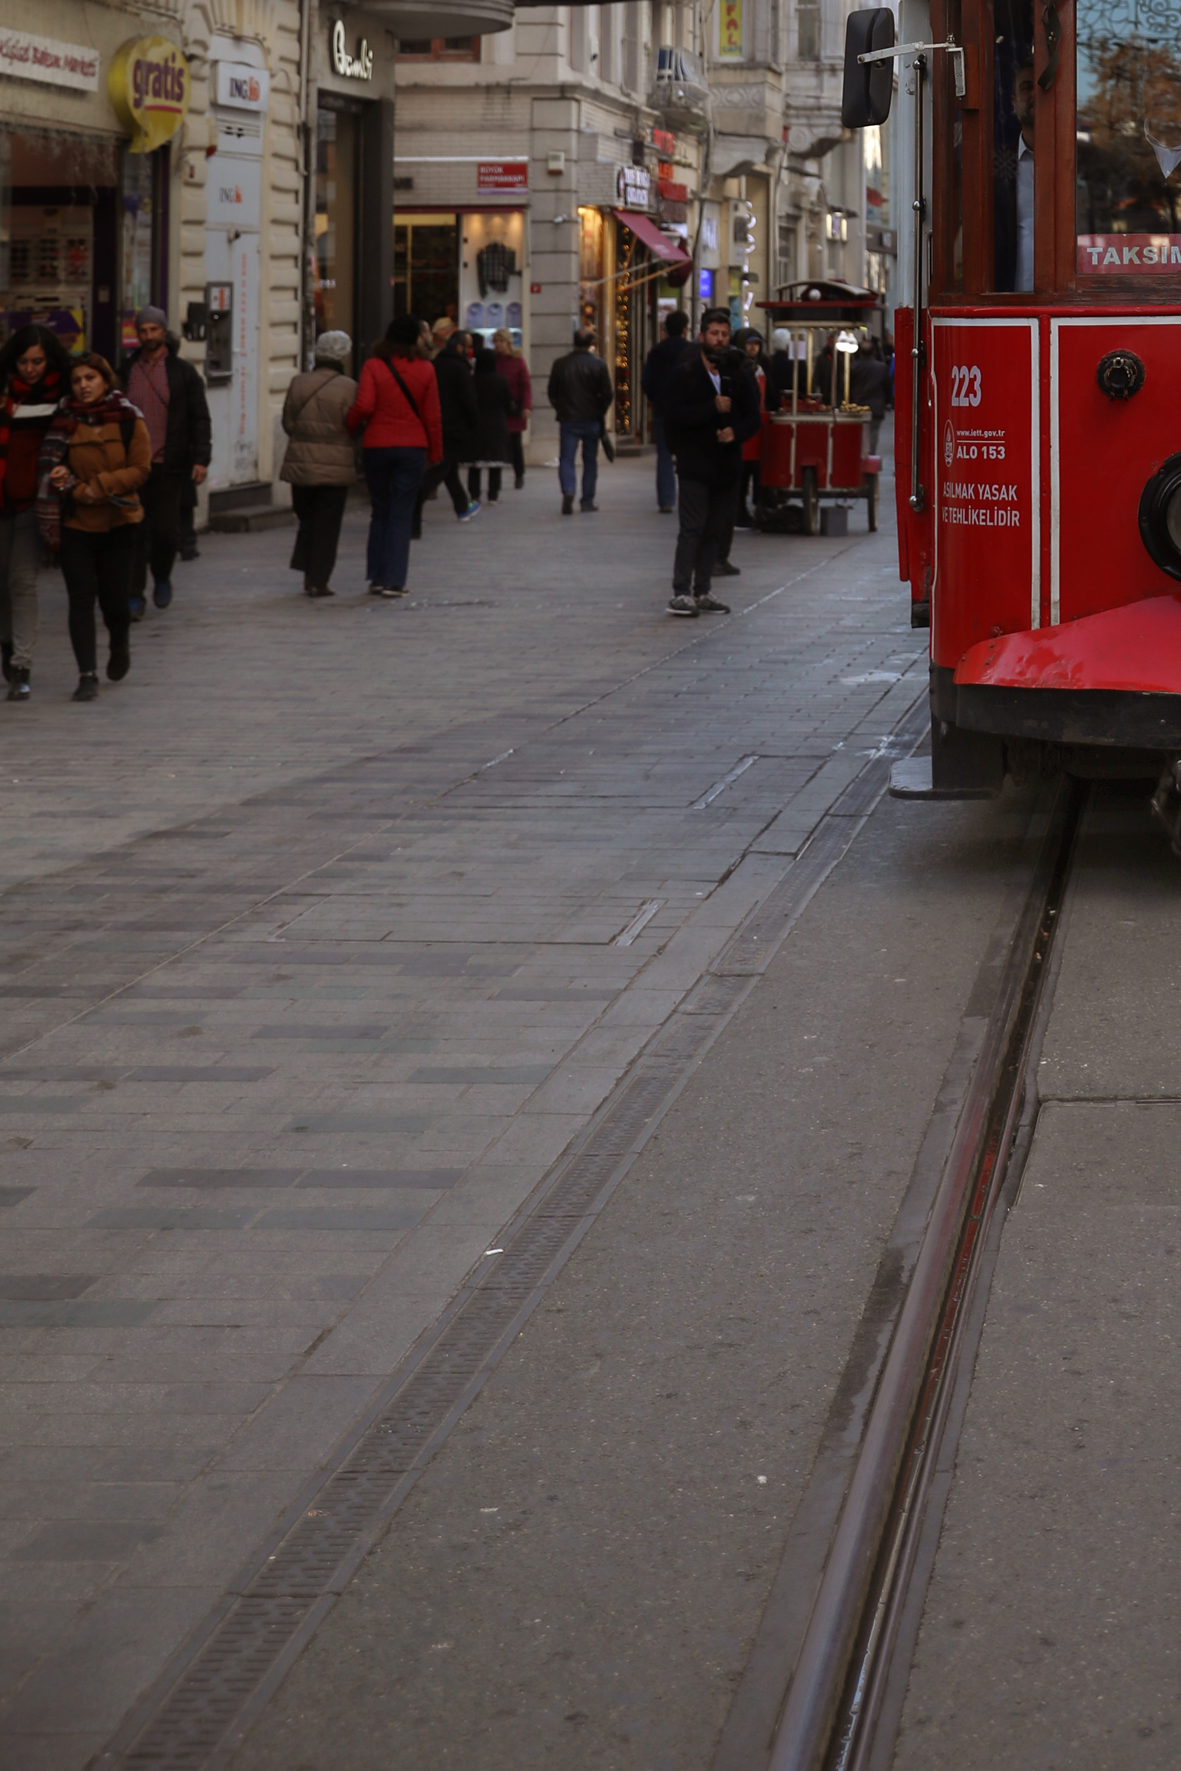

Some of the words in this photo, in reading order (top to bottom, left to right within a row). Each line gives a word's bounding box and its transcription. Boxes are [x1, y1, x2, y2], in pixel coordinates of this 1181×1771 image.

[133, 52, 184, 109] gratis
[229, 77, 249, 100] ING
[951, 365, 981, 407] 223
[957, 429, 1005, 438] www.iett.gov.tr
[957, 446, 978, 459] ALO
[982, 446, 1006, 459] 153
[943, 481, 975, 499] ASILMAK
[977, 484, 1018, 501] YASAK
[942, 506, 949, 522] VE
[949, 505, 1020, 526] TEHLİKELİDİR
